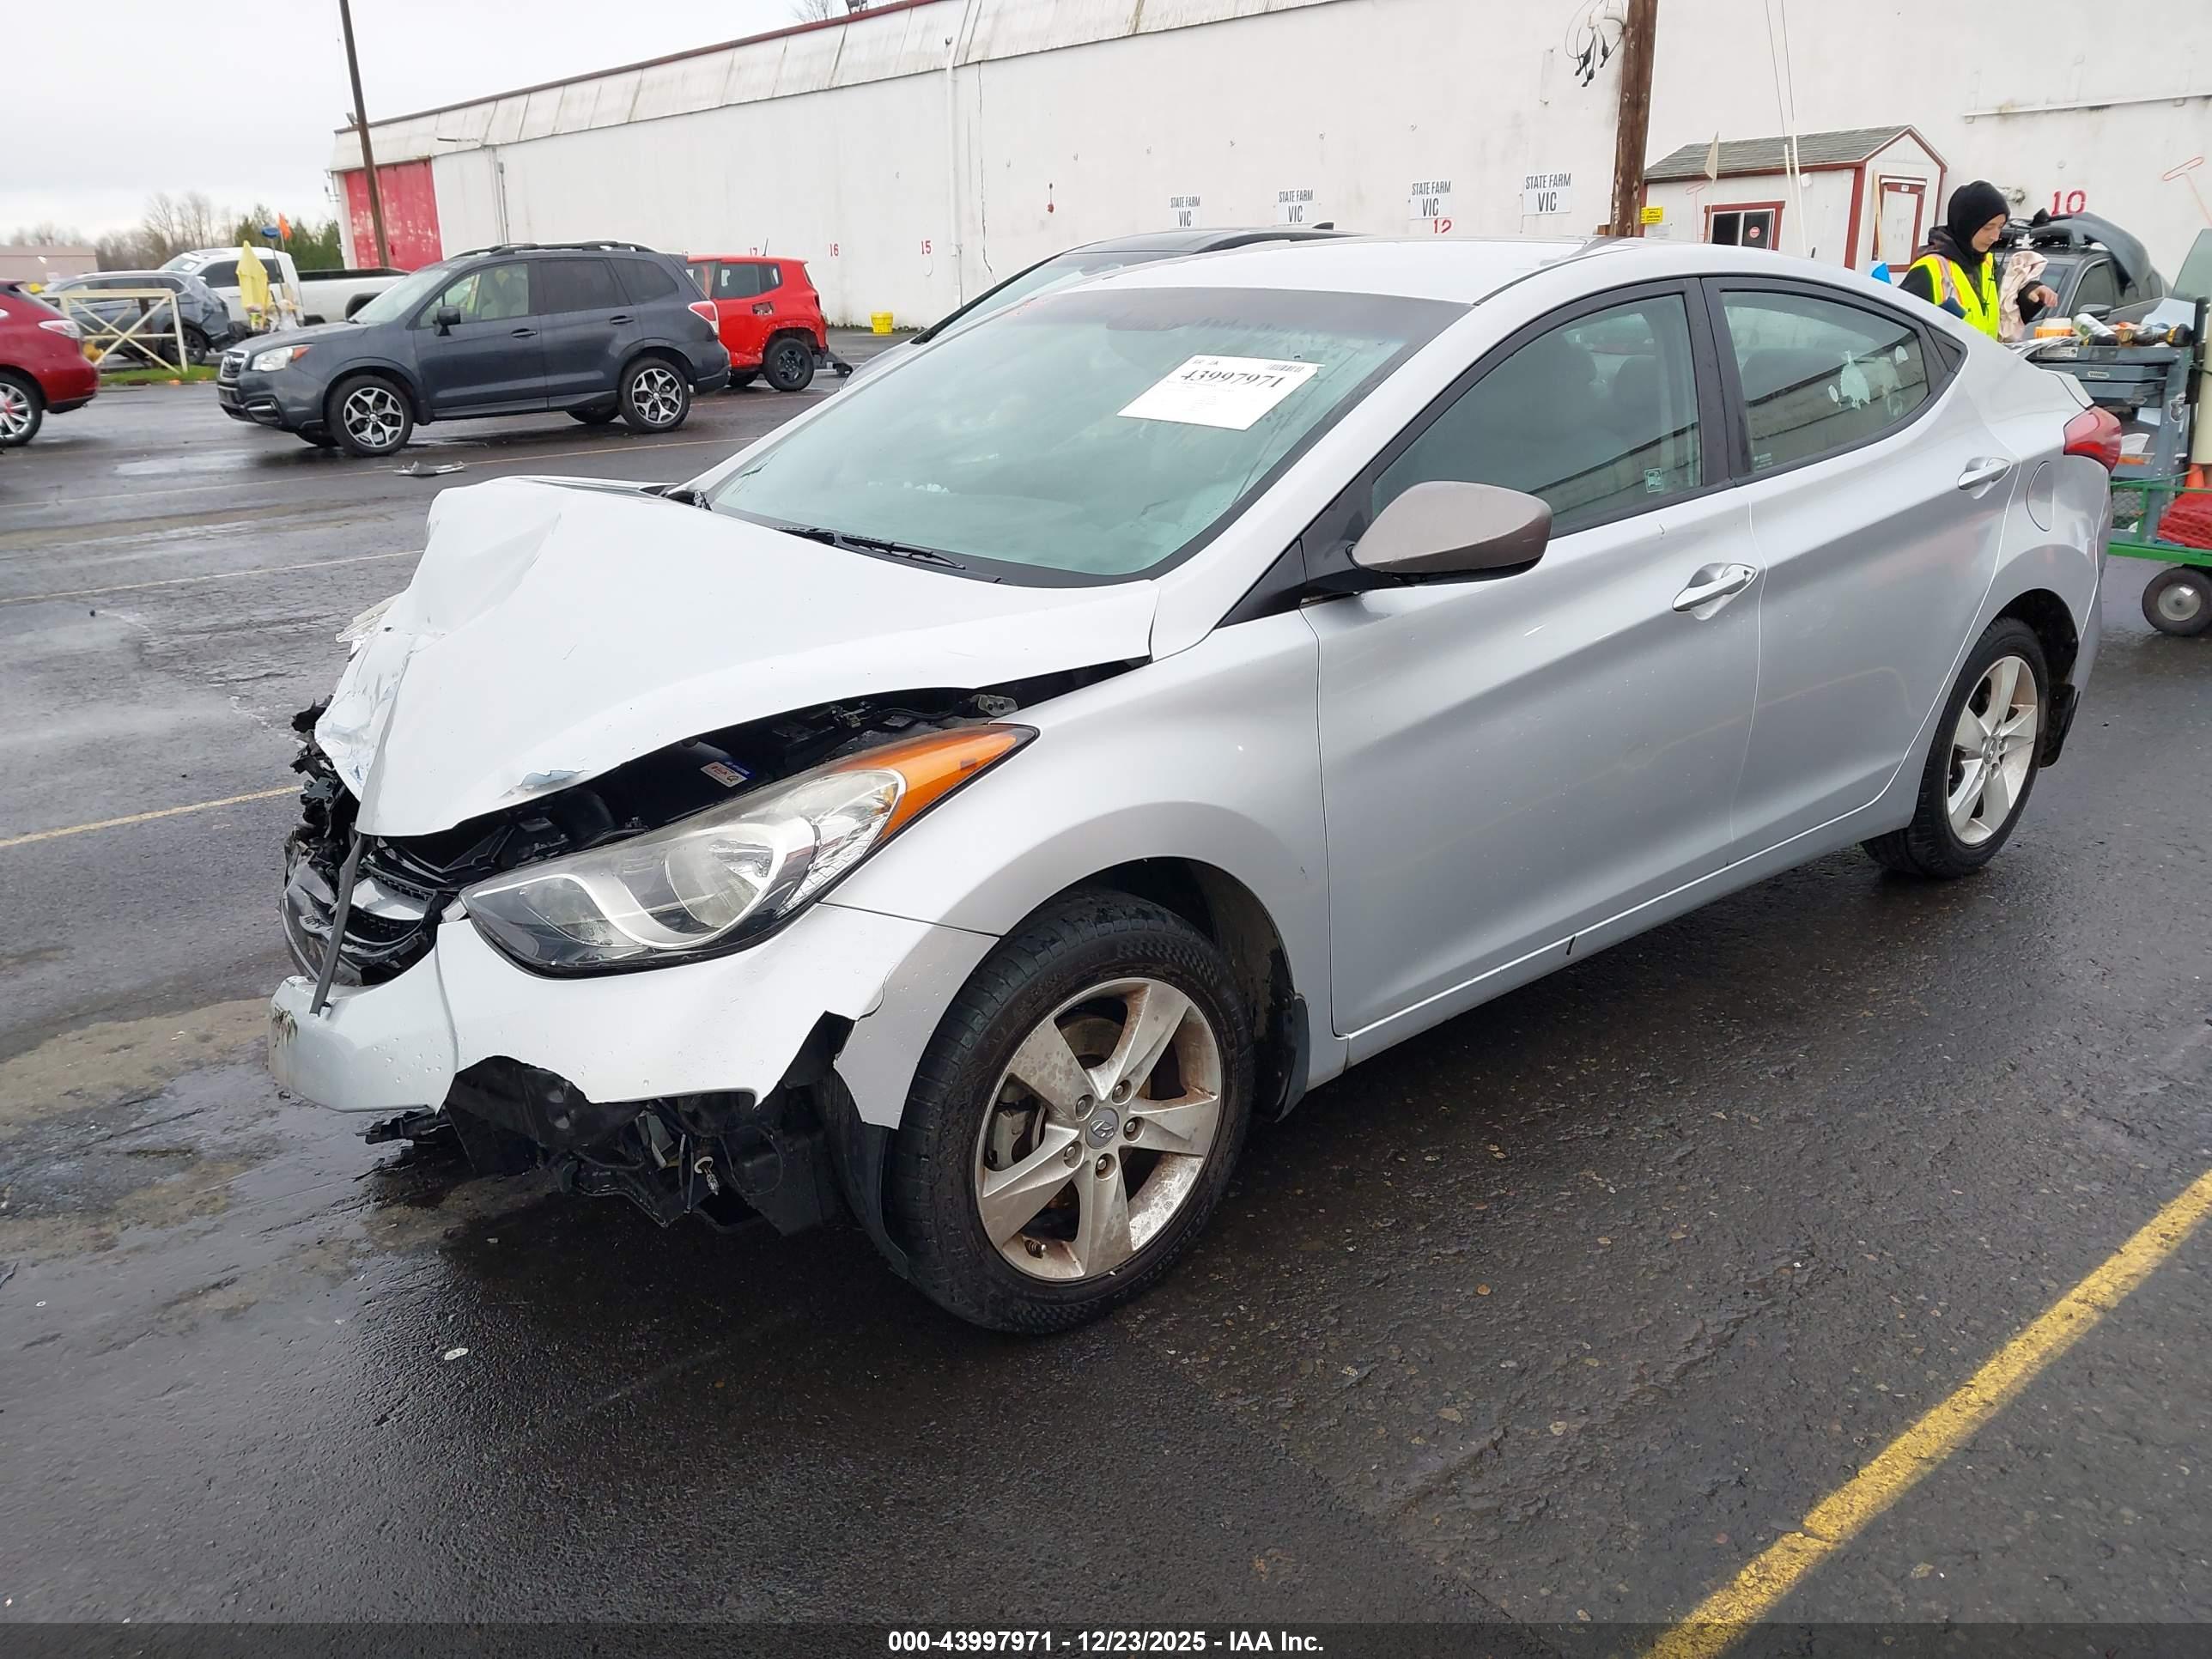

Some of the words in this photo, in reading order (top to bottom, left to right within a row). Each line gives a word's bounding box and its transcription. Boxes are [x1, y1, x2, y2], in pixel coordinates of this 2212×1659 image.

[1412, 182, 1431, 196] STATE
[1431, 180, 1451, 195] FARM
[1525, 174, 1547, 190] STATE
[1548, 173, 1571, 188] FARM
[1170, 197, 1185, 208] STATE
[1185, 196, 1200, 208] FARM
[1279, 191, 1295, 204] STATE
[1296, 189, 1314, 202] FARM
[1537, 191, 1557, 213] VIC
[2050, 190, 2087, 216] 10
[1288, 205, 1303, 223] VIC
[1422, 198, 1439, 217] VIC
[1179, 210, 1192, 228] VIC
[830, 244, 839, 256] 16
[921, 240, 932, 254] 15
[1181, 369, 1286, 388] 43997971
